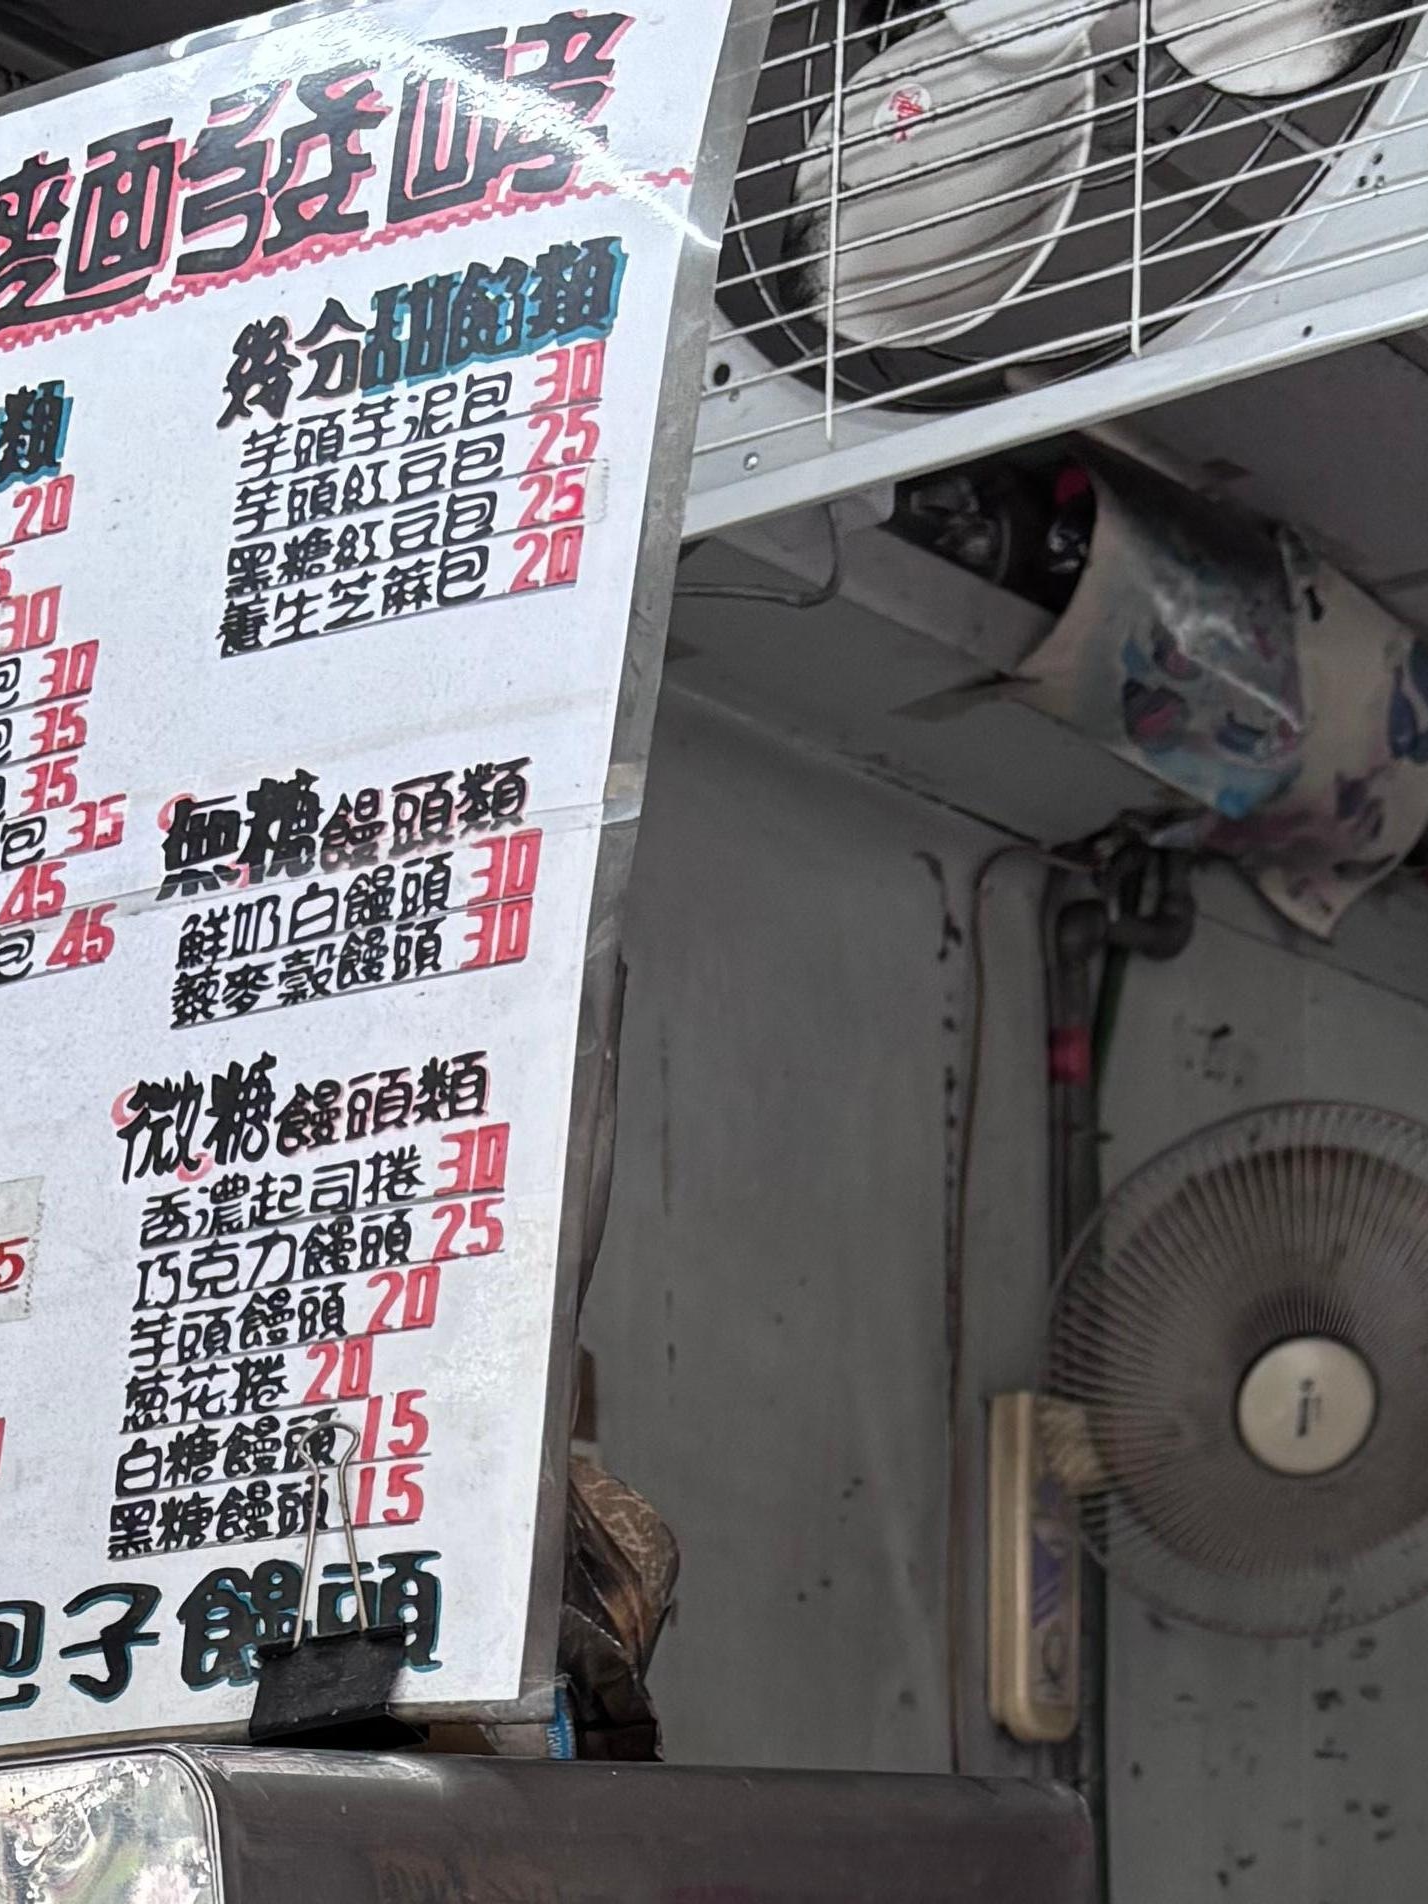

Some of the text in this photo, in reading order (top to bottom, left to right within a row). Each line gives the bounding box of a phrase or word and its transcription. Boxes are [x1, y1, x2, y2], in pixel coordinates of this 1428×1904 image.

[236, 341, 606, 484] 芋頭芋泥包 30
[12, 475, 74, 542] 20
[232, 404, 601, 541] 芋頭紅豆包 25
[224, 468, 586, 598] 黑糖紅豆包 25
[508, 526, 584, 593] 20
[35, 640, 99, 700] 30
[29, 700, 88, 760] 35
[19, 757, 79, 816] 35
[65, 794, 127, 854] 35
[155, 756, 532, 901] 無糖饅頭類
[45, 903, 118, 970] 45
[174, 828, 543, 970] 鮮奶白饅頭 30
[458, 902, 533, 971] 30
[119, 1050, 489, 1185] 微糖饅頭類
[139, 1122, 509, 1250] 香濃起司捲 30
[133, 1197, 505, 1312] 巧克力饅頭 25
[127, 1265, 441, 1371] 芋頭饅頭 20
[301, 1336, 374, 1405] 20
[115, 1388, 430, 1499] 白糖饅頭 15
[107, 1464, 425, 1562] 黑糖饅頭 15
